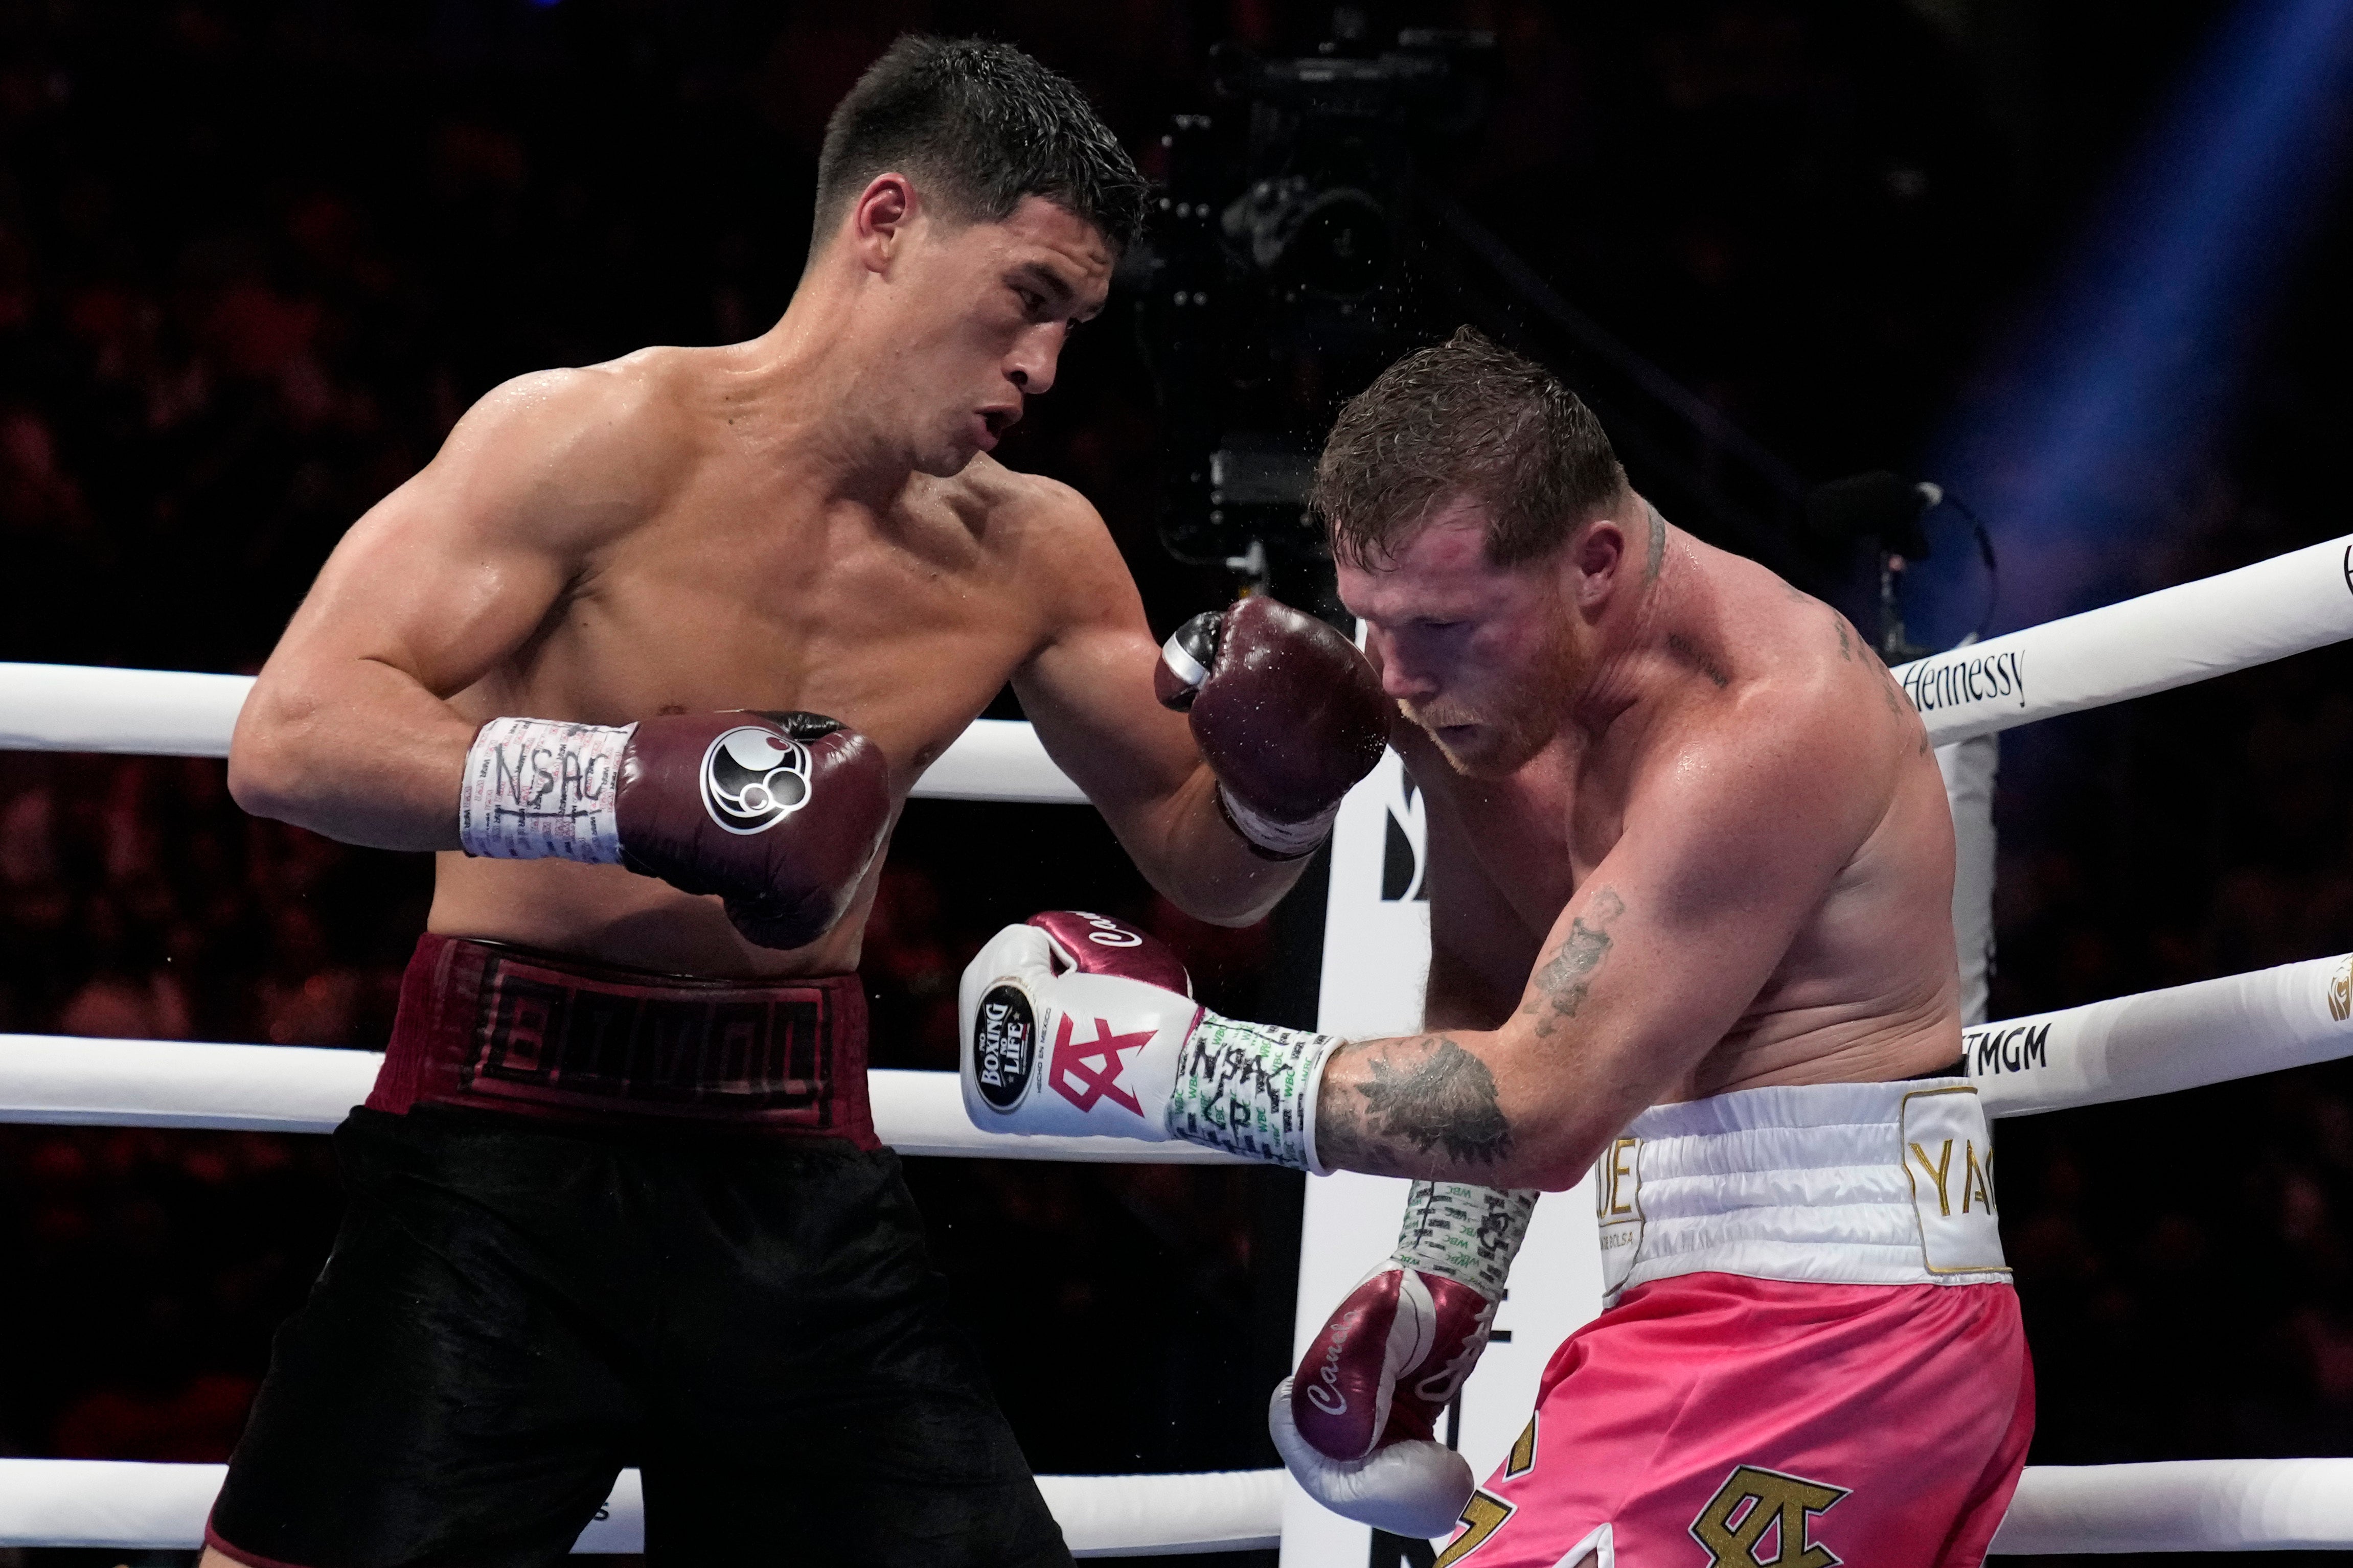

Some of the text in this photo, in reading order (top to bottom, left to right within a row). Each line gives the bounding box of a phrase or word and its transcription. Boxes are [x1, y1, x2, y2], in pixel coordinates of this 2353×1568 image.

[1904, 650, 2025, 712] Hennessy
[494, 743, 609, 805] NSAC
[980, 1003, 1009, 1088] BOXING
[1000, 1037, 1008, 1056] NO
[1040, 1007, 1052, 1044] MEXICO
[1004, 1022, 1024, 1075] LIFE
[1038, 1046, 1044, 1059] EN
[1962, 1022, 2052, 1076] TMGM
[1284, 1069, 1295, 1098] WBC
[1256, 1106, 1268, 1132] WBC
[1446, 1186, 1471, 1198] WBC
[1908, 1139, 1998, 1216] YA
[1443, 1234, 1469, 1249] WBC
[1307, 1311, 1360, 1416] Canelo
